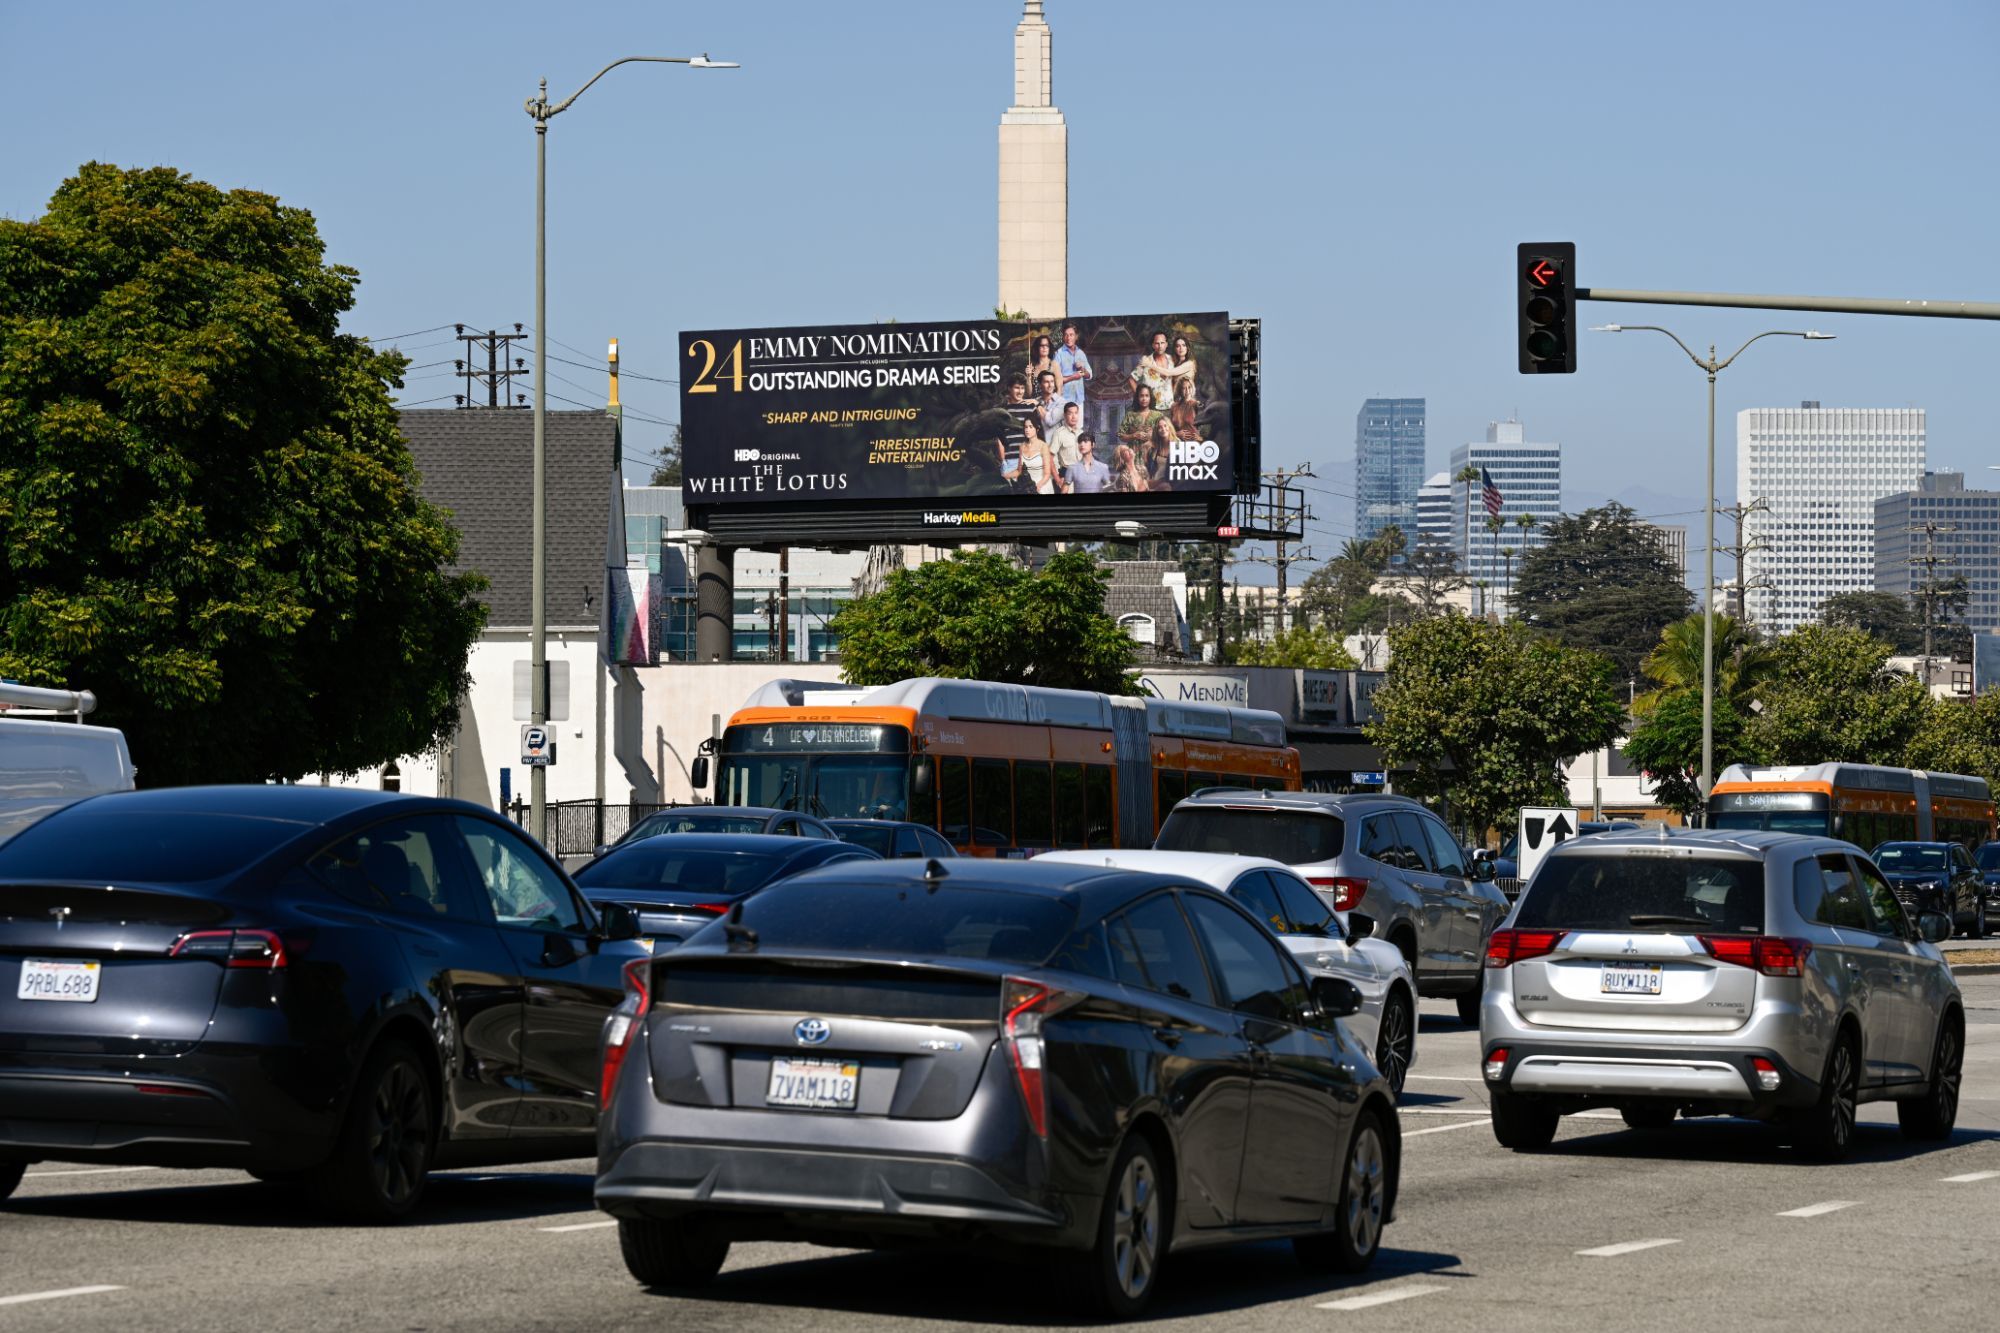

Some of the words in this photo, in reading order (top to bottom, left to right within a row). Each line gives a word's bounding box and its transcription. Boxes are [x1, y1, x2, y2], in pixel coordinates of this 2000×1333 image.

[830, 329, 1000, 357] NOMINATIONS
[688, 339, 747, 393] 24
[749, 369, 872, 392] OUTSTANDING
[876, 367, 939, 388] DRAMA
[943, 364, 1001, 385] SERIES
[810, 410, 838, 423] AND
[734, 449, 760, 462] HBO
[761, 452, 801, 461] ORIGINAL
[1169, 441, 1220, 464] HBO
[752, 465, 783, 476] THE
[1169, 464, 1218, 481] max
[689, 475, 765, 494] WHITE
[777, 473, 847, 491] LOTUS
[923, 511, 997, 526] HarkeyMedia
[1219, 527, 1238, 536] 1117
[984, 685, 1004, 718] Go
[1007, 687, 1047, 721] Metro
[1319, 680, 1338, 705] SHOP
[762, 727, 774, 747] 4
[790, 729, 802, 743] WE
[817, 729, 832, 743] LOS
[1734, 794, 1743, 807] 4
[1748, 794, 1776, 806] SANTA
[24, 972, 92, 994] 9RBL688
[775, 1074, 852, 1103] 7VAM118
